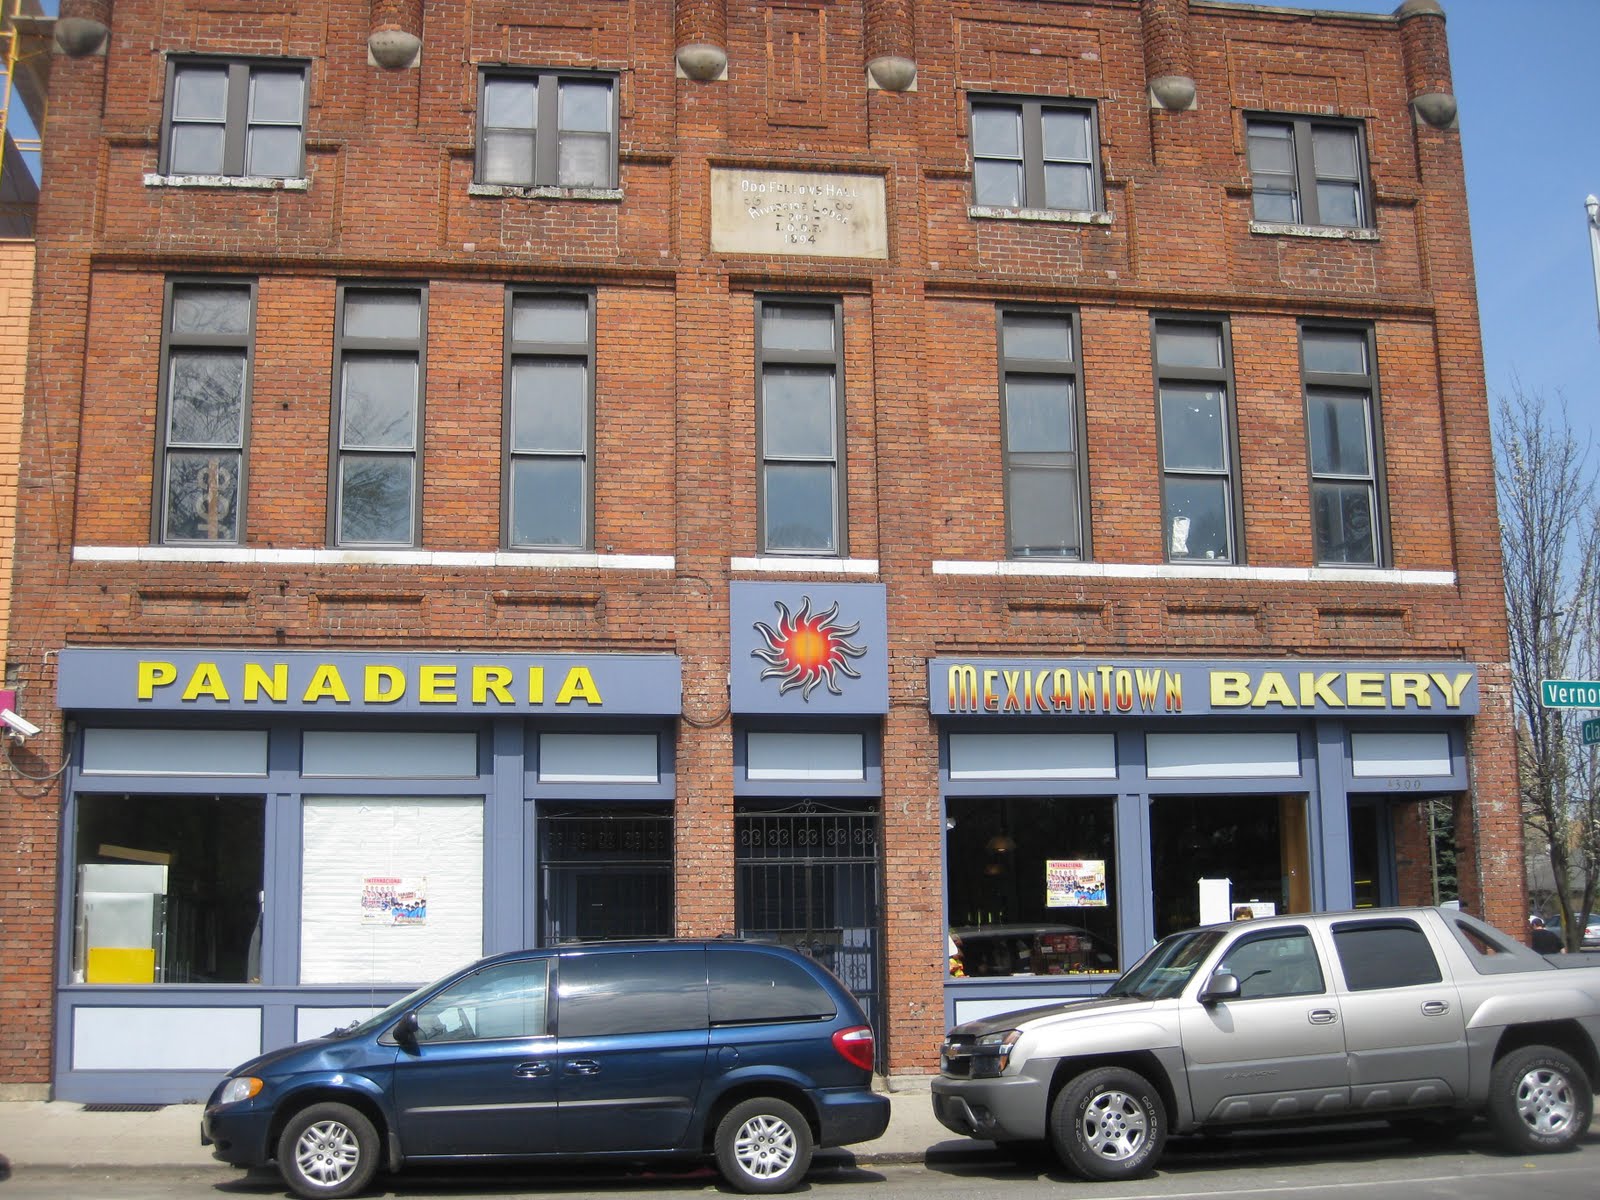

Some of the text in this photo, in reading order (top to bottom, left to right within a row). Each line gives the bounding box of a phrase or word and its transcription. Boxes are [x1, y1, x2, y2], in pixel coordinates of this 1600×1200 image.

[741, 180, 766, 193] ODD
[825, 184, 859, 198] HALL
[784, 234, 816, 244] 1894
[137, 661, 603, 705] PANADERIA
[1209, 671, 1473, 709] BAKERY
[1548, 684, 1600, 704] Verno
